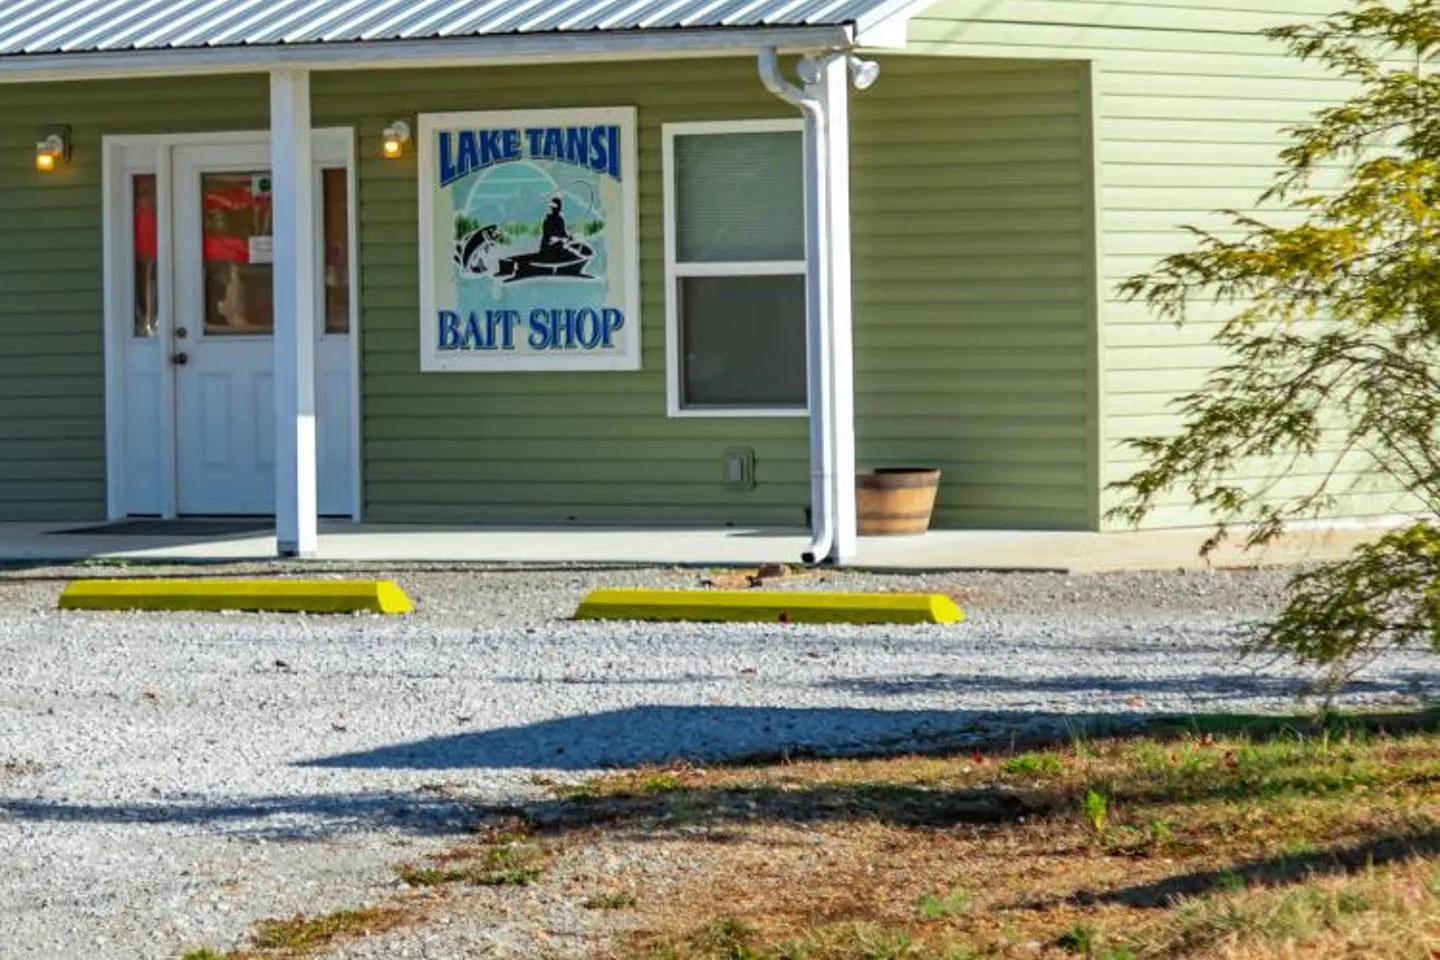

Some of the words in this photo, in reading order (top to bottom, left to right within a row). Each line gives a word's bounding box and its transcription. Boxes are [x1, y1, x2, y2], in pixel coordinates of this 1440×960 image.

[437, 128, 521, 187] LAKE
[524, 125, 622, 183] TANSI
[437, 309, 521, 350] BAIT
[527, 308, 625, 350] SHOP
